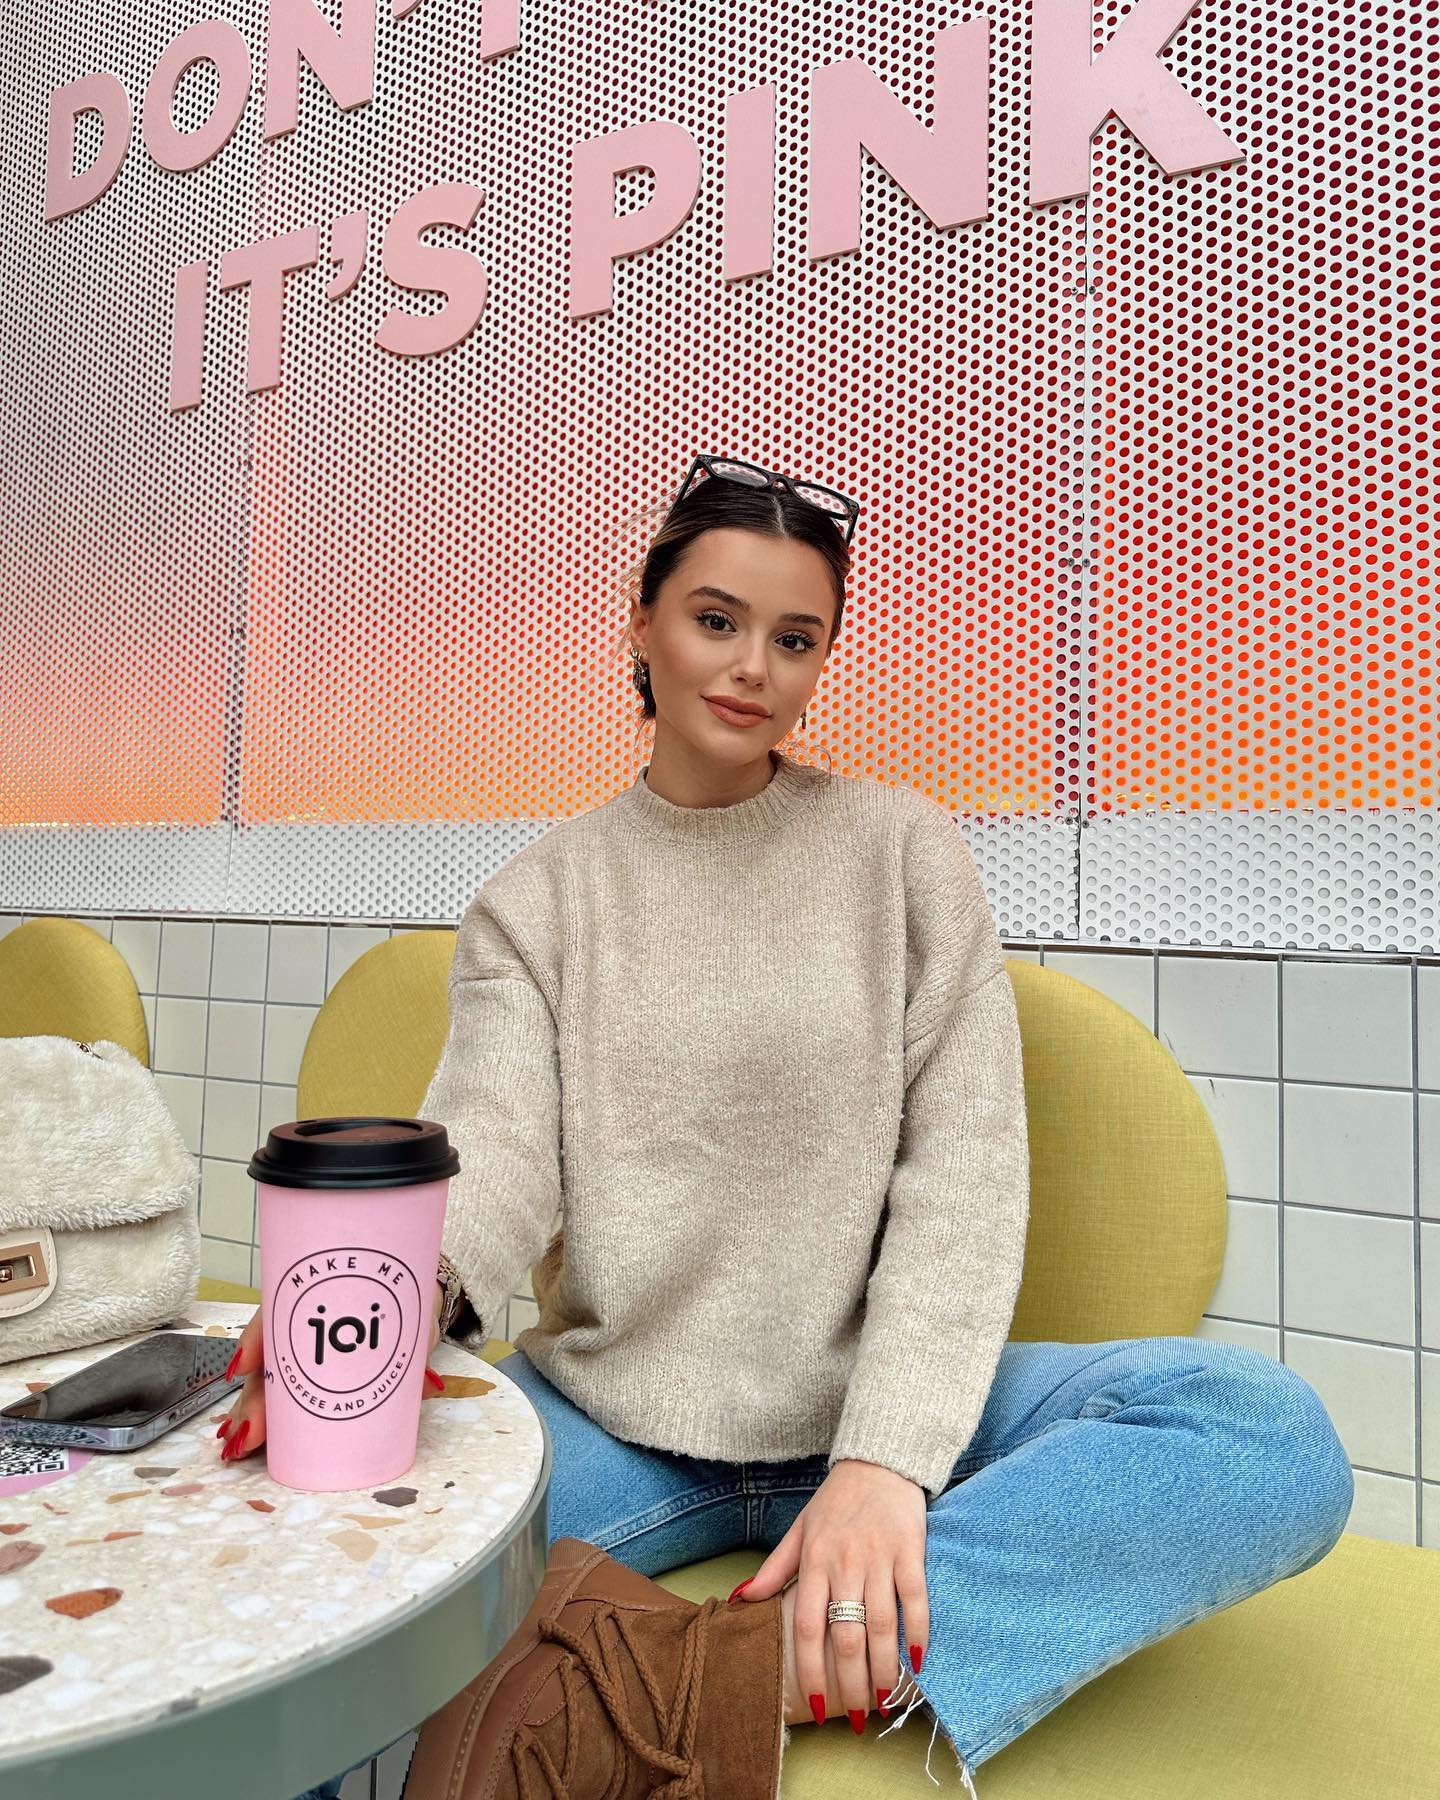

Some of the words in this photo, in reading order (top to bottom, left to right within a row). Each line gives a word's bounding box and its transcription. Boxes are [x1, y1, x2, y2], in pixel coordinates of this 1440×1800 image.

[44, 0, 521, 223] DON
[170, 182, 488, 412] IT'S
[569, 0, 1247, 320] PINK
[291, 1256, 357, 1288] MAKE
[378, 1262, 404, 1286] ME
[284, 1364, 326, 1409] COFFEE
[333, 1398, 365, 1412] AND
[372, 1361, 403, 1400] JUICE
